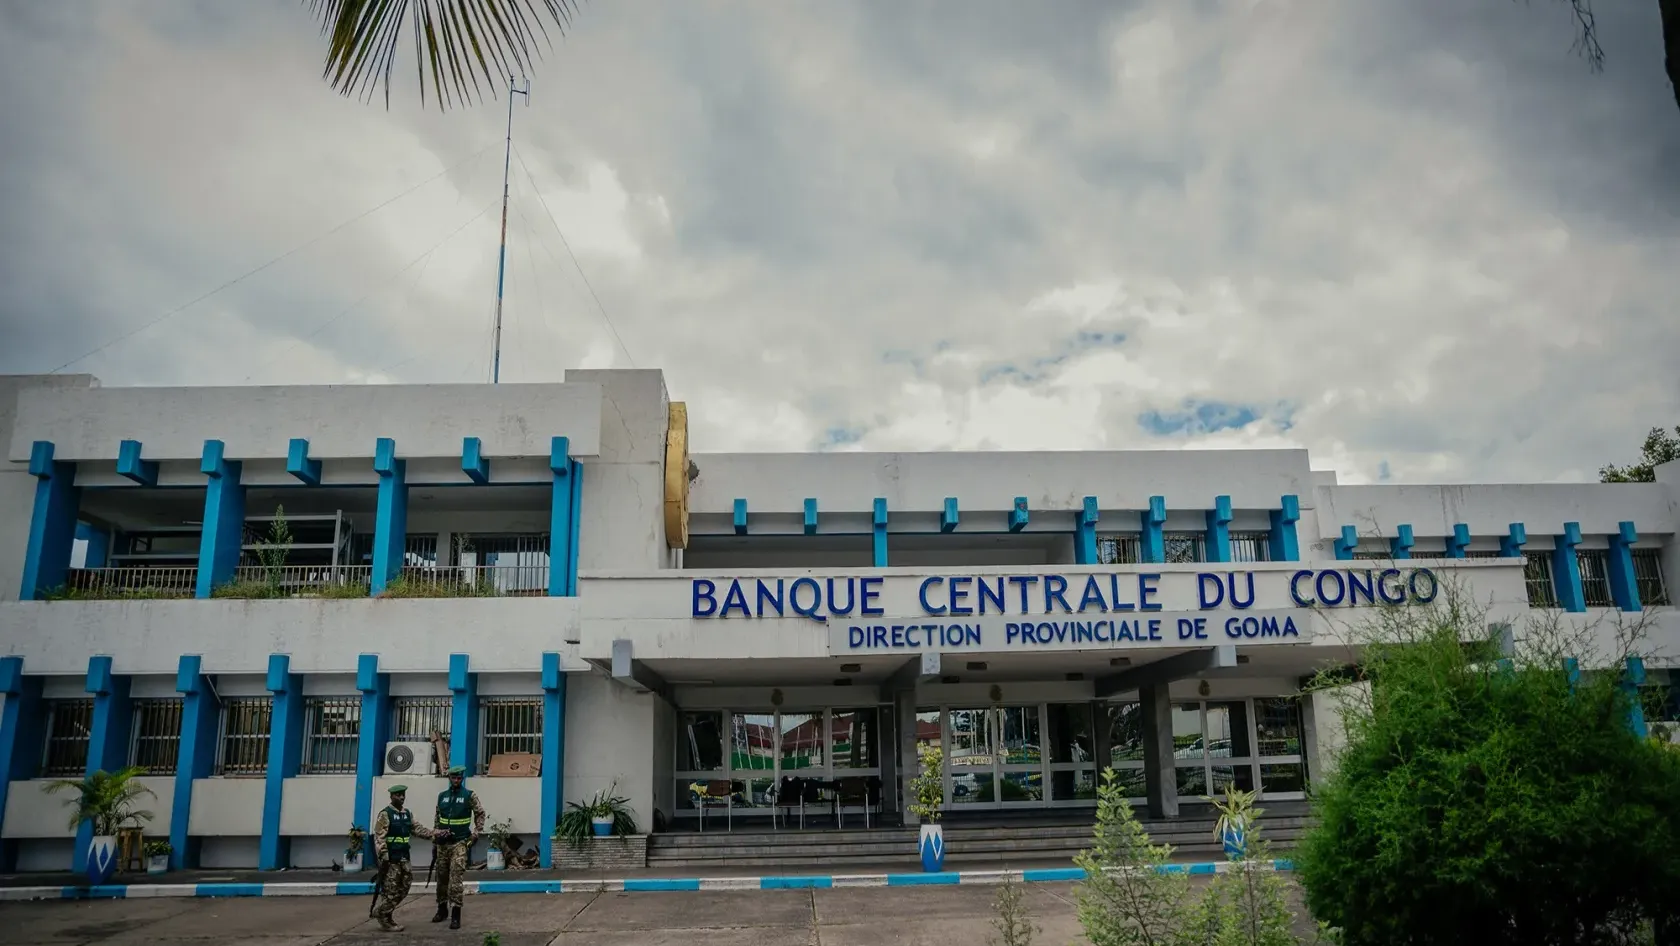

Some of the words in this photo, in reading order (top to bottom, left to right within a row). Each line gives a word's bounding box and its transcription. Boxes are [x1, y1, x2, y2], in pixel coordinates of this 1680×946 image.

[692, 577, 885, 622] BANQUE
[919, 574, 1163, 615] CENTRALE
[1198, 572, 1256, 610] DU
[1290, 567, 1438, 608] CONGO
[849, 623, 982, 648] DIRECTION
[1005, 619, 1163, 645] PROVINCIALE
[1178, 618, 1208, 640] DE
[1224, 615, 1300, 639] GOMA
